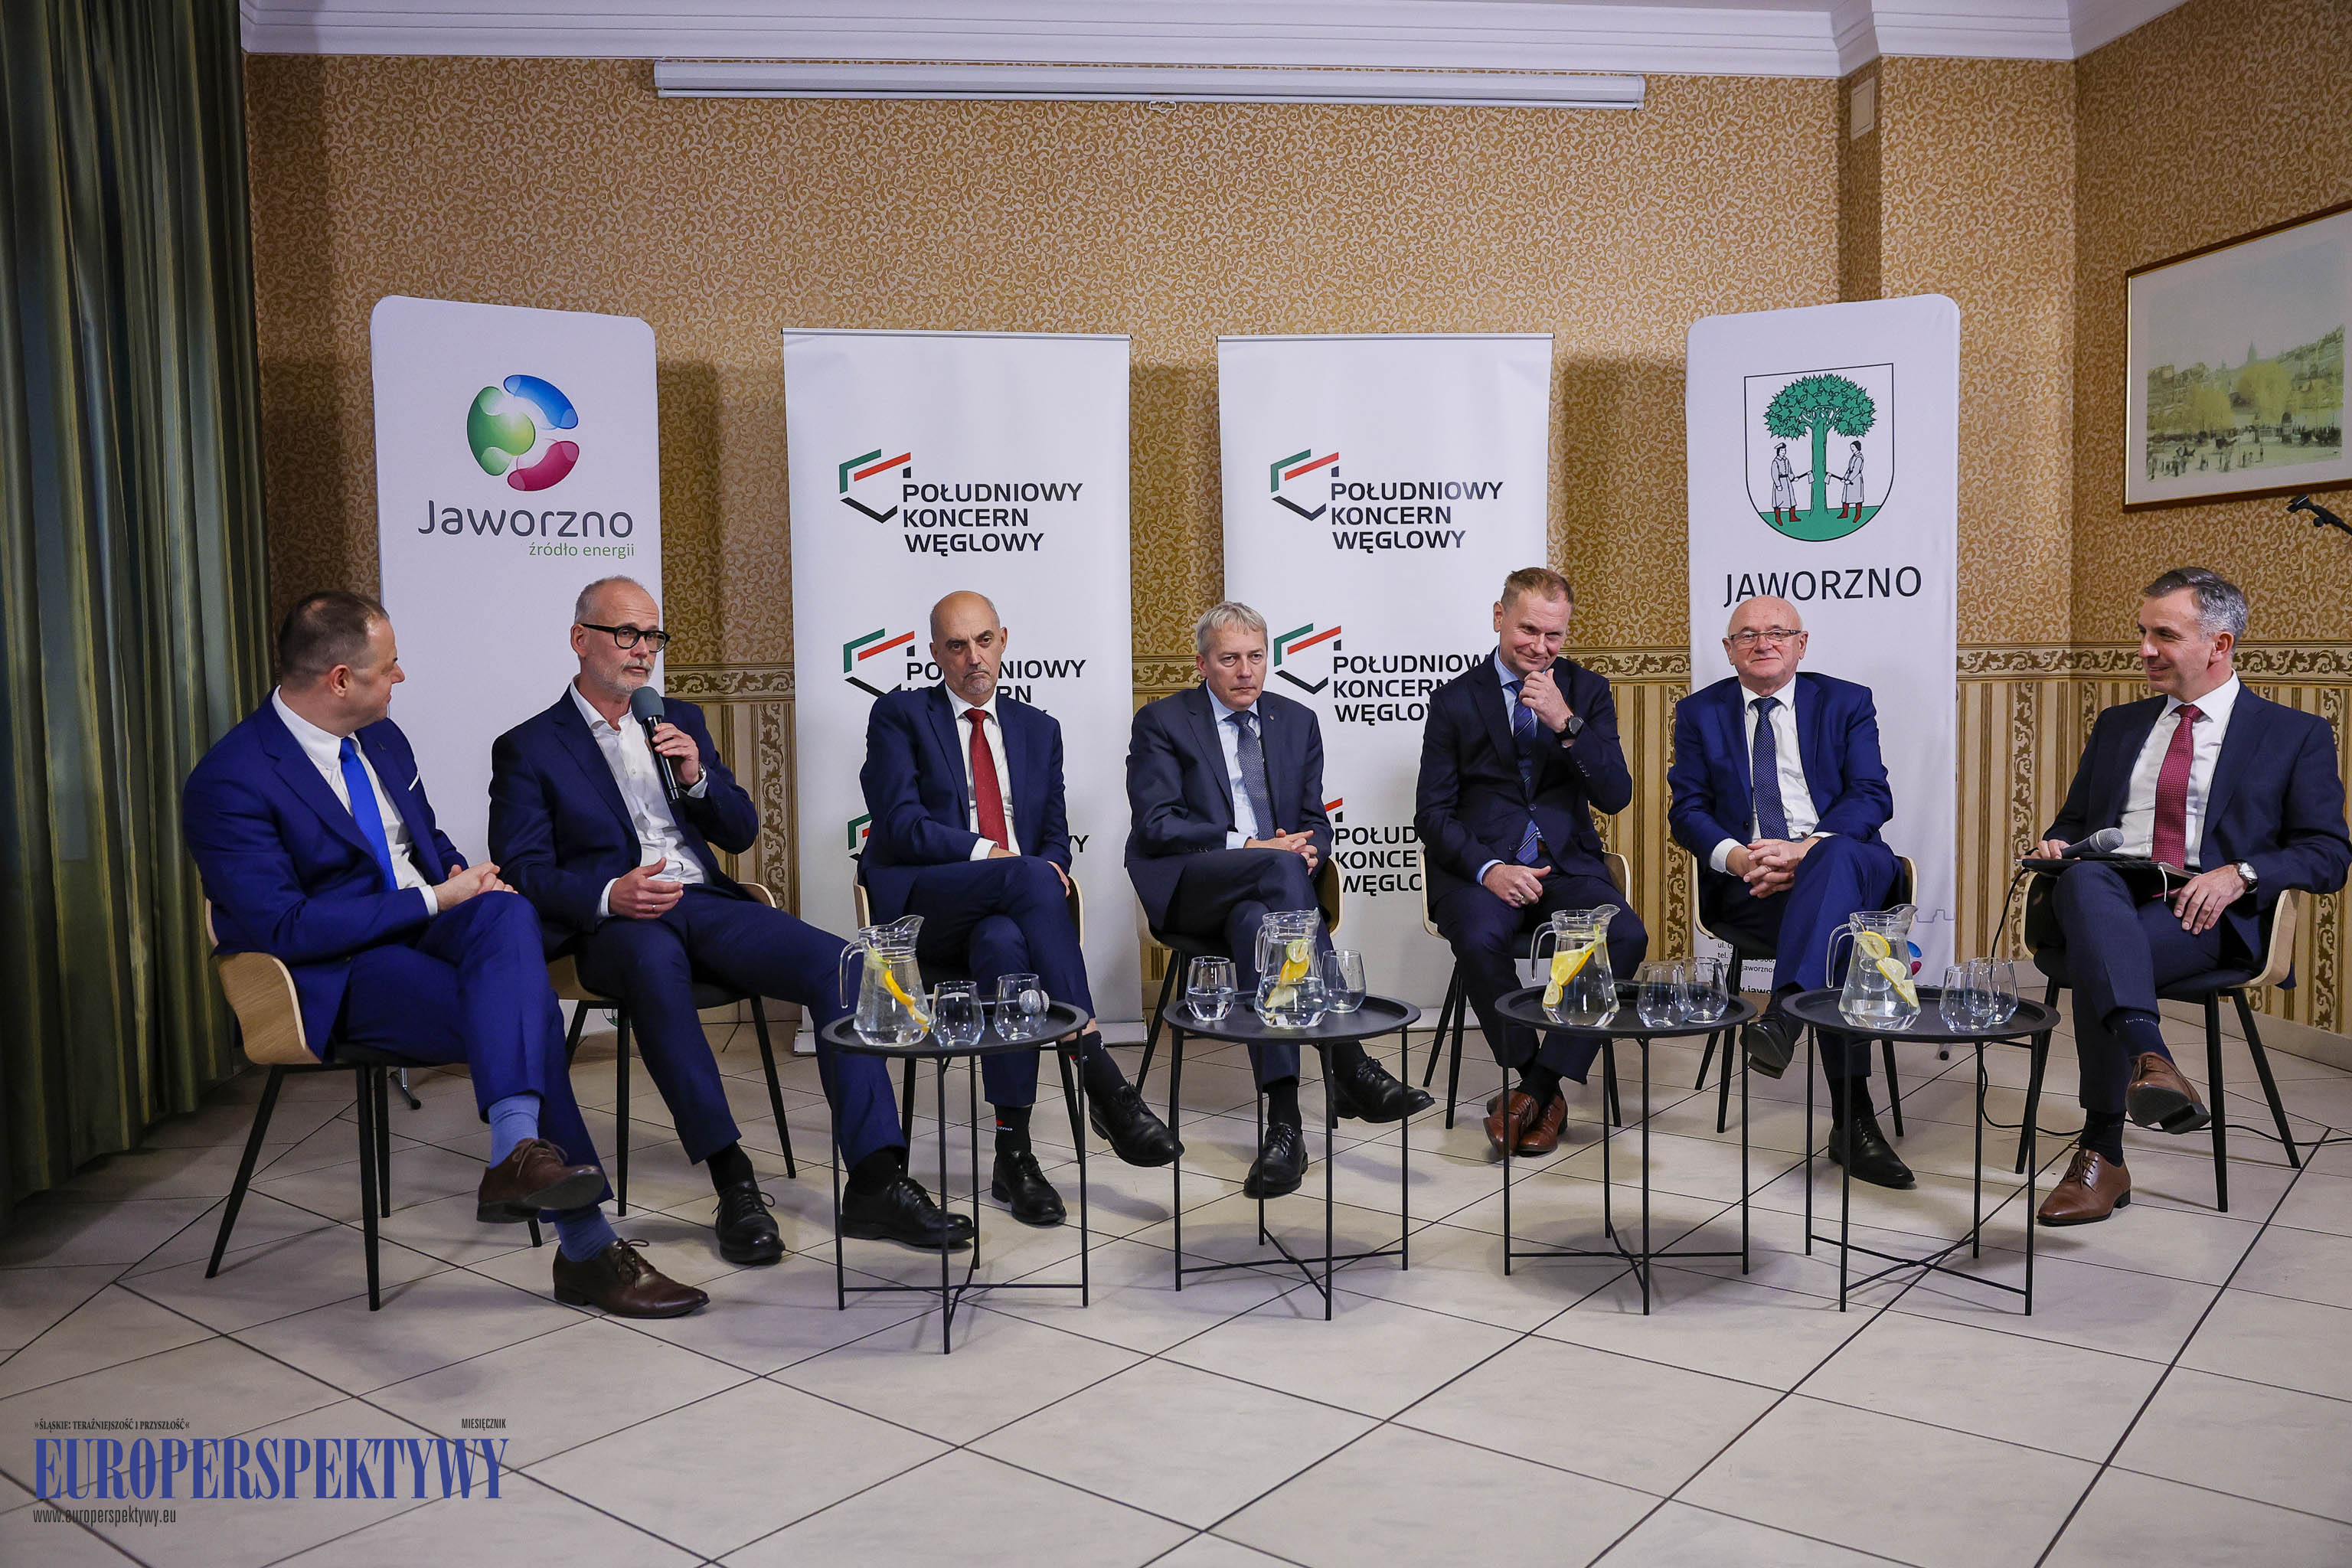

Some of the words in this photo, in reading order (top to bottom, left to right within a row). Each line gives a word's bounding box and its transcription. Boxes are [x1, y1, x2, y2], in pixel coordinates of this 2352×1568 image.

[903, 483, 1083, 503] POŁUDNIOWY
[1331, 482, 1504, 501] POŁUDNIOWY
[418, 500, 633, 537] Jaworzno
[903, 508, 1028, 528] KONCERN
[1331, 506, 1451, 525] KONCERN
[529, 542, 578, 557] źródło
[583, 544, 635, 560] energii
[904, 532, 1044, 557] WĘGLOWY
[1332, 530, 1466, 554] WĘGLOWY
[1723, 566, 1922, 608] JAWORZNO
[906, 659, 1086, 681] PONIOWY
[1333, 655, 1489, 675] POŁUDNIOW
[1334, 703, 1430, 726] WĘGLO
[1335, 826, 1418, 845] POŁUD
[1335, 851, 1416, 869] KONCE
[1343, 874, 1423, 897] WĘGLO
